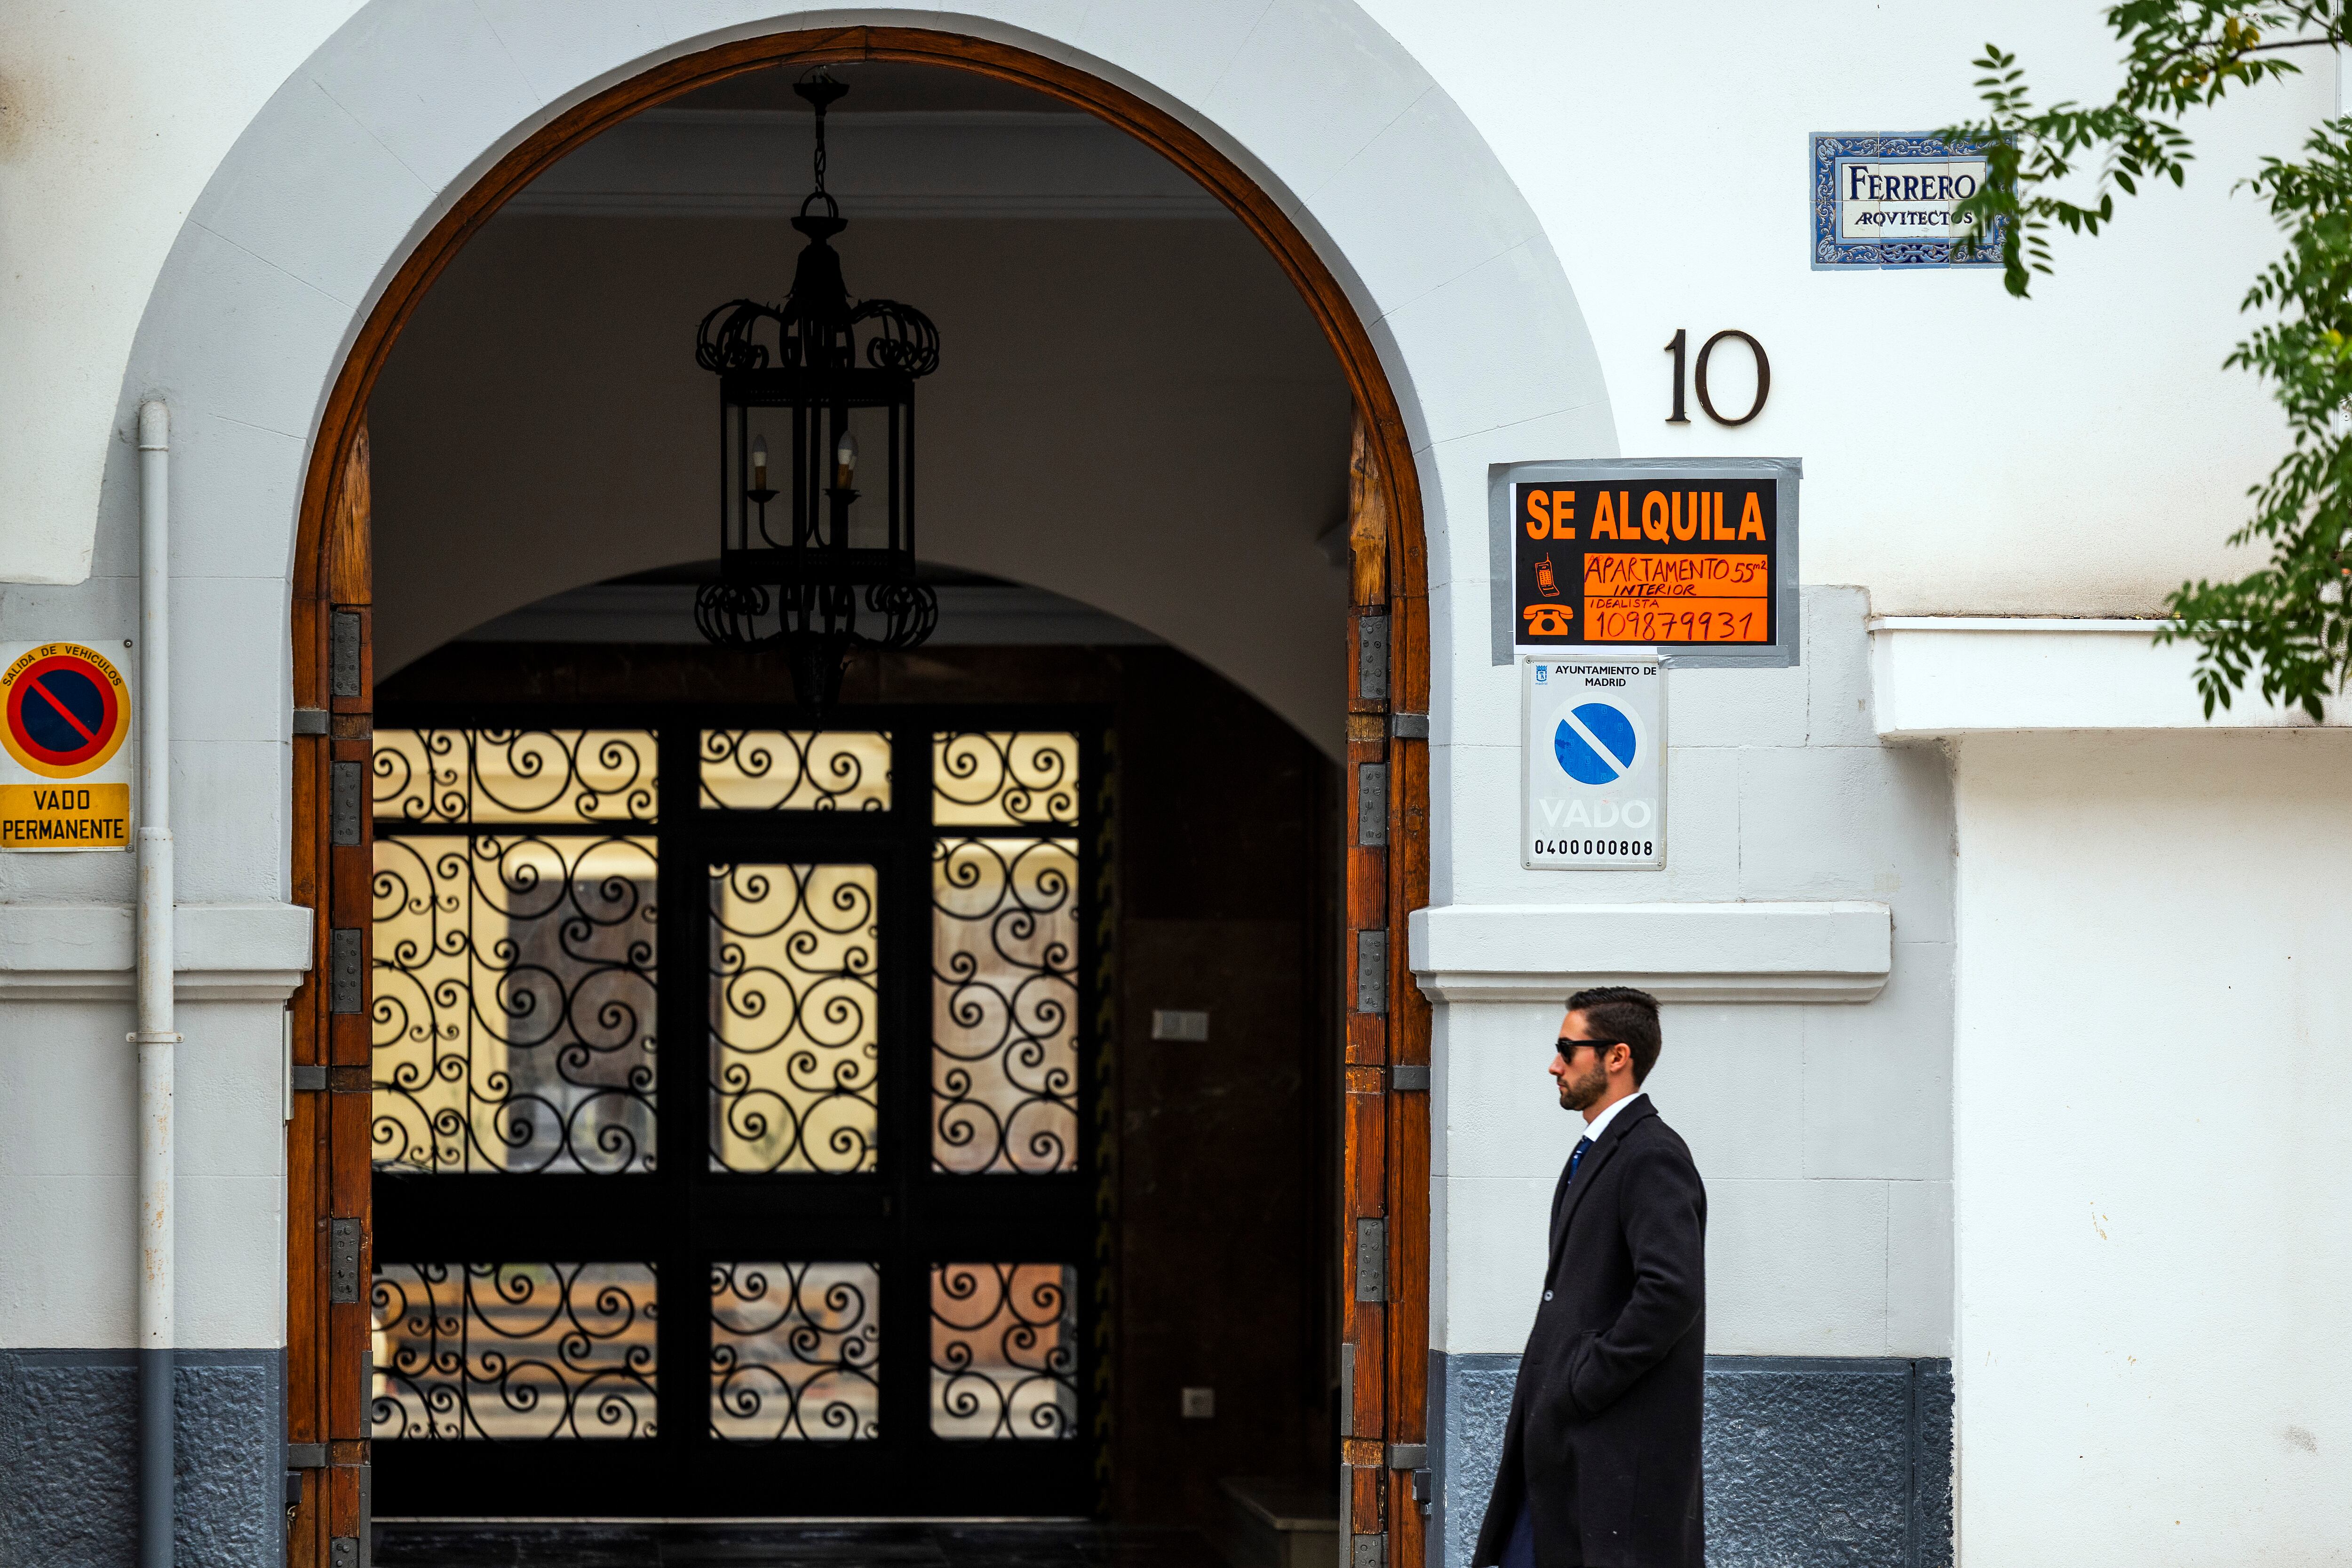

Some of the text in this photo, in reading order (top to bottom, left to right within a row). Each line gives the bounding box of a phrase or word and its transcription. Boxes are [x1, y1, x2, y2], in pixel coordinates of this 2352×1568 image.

[1664, 329, 1770, 426] 10
[1526, 490, 1766, 545] SE ALQUILA
[1585, 557, 1730, 583] APARTAMENTO
[1613, 583, 1697, 597] INTERIOR
[1590, 599, 1660, 609] IDEALISTA
[1596, 611, 1753, 641] 109879931
[3, 645, 121, 686] SALIDA DE VEHICULOS
[1555, 665, 1657, 676] AYUNTAMIENTO DE
[1585, 678, 1626, 687] MADRID
[33, 790, 89, 810] VADO
[1539, 799, 1652, 828] VADO
[3, 819, 124, 840] PERMANENTE
